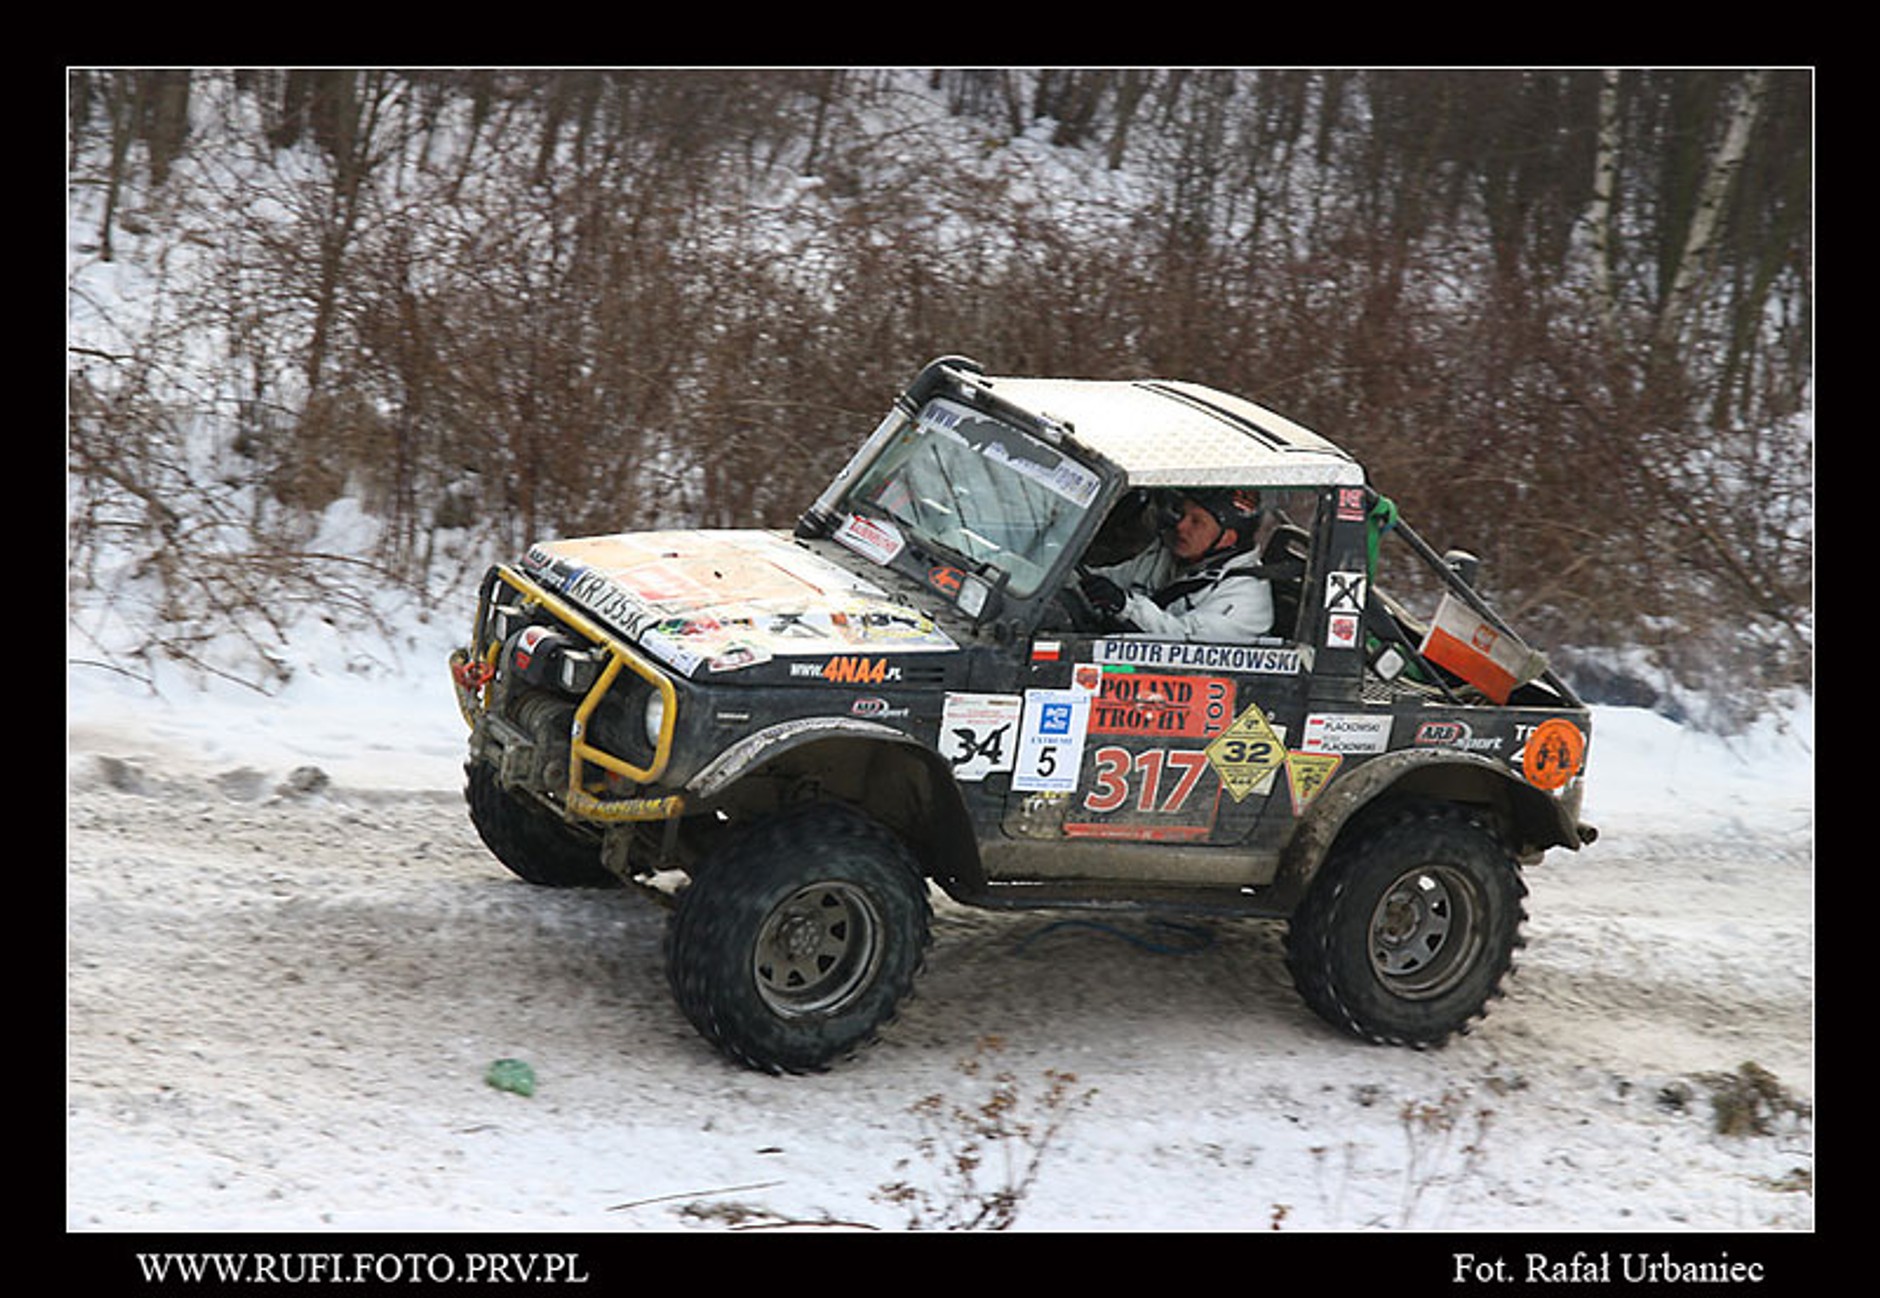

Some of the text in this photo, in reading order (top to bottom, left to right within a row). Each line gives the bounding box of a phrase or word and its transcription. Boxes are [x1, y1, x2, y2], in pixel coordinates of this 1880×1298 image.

[570, 570, 605, 603] KR
[1104, 641, 1300, 672] PIOTR PLACKOWSKI
[1100, 679, 1193, 702] POLAND
[1096, 707, 1191, 730] TROPHY
[1203, 683, 1227, 735] TOU
[951, 722, 1012, 765] 34
[1222, 740, 1273, 764] 32
[1036, 745, 1058, 778] 5
[1083, 745, 1210, 814] 317
